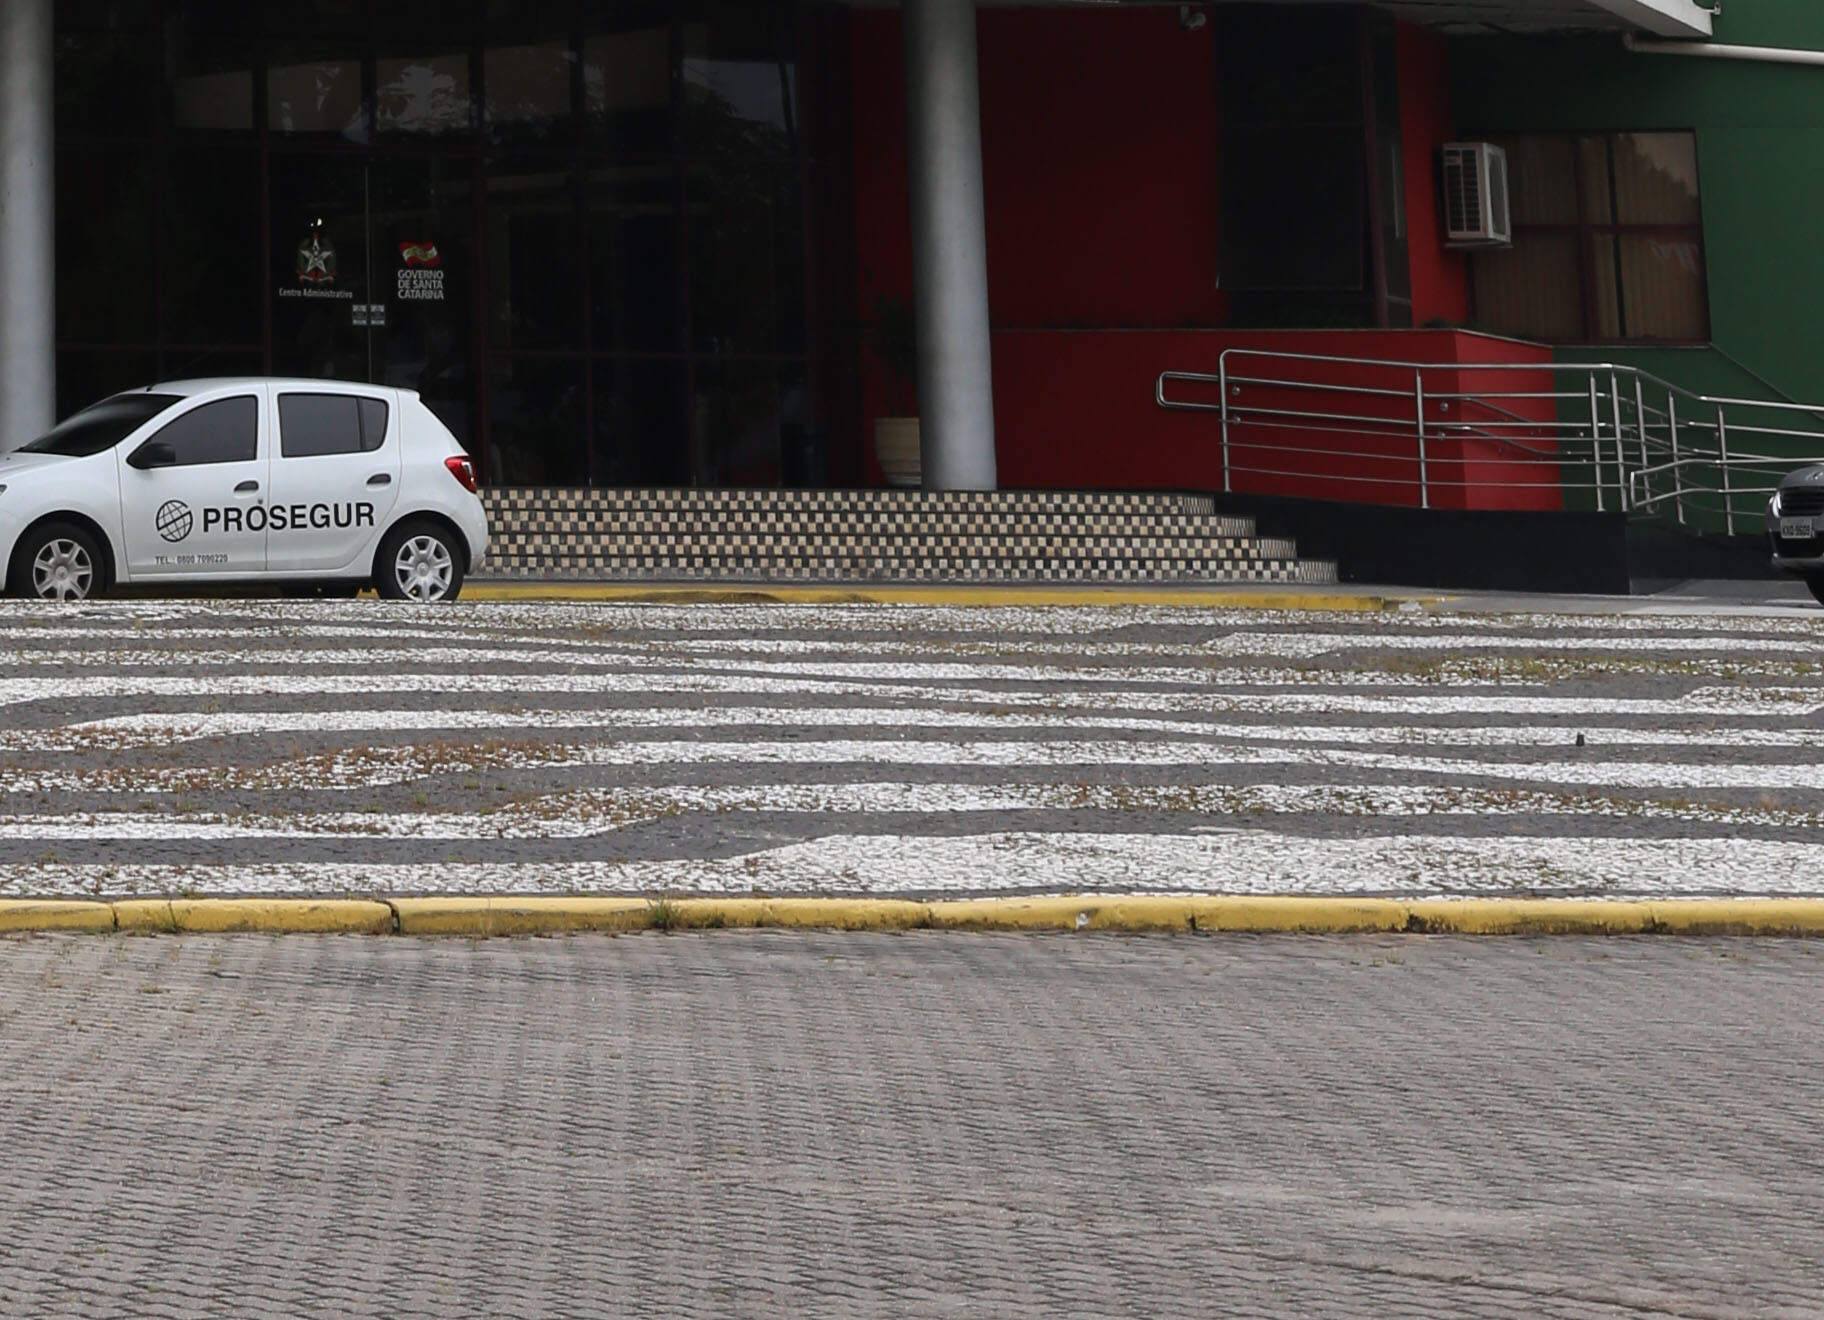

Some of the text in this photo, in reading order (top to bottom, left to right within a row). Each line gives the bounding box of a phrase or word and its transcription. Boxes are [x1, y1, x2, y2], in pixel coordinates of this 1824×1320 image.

[397, 269, 444, 280] GOVERNO
[397, 279, 444, 289] DE SANTA
[397, 289, 444, 300] CATARINA
[203, 502, 375, 532] PROSEGUR
